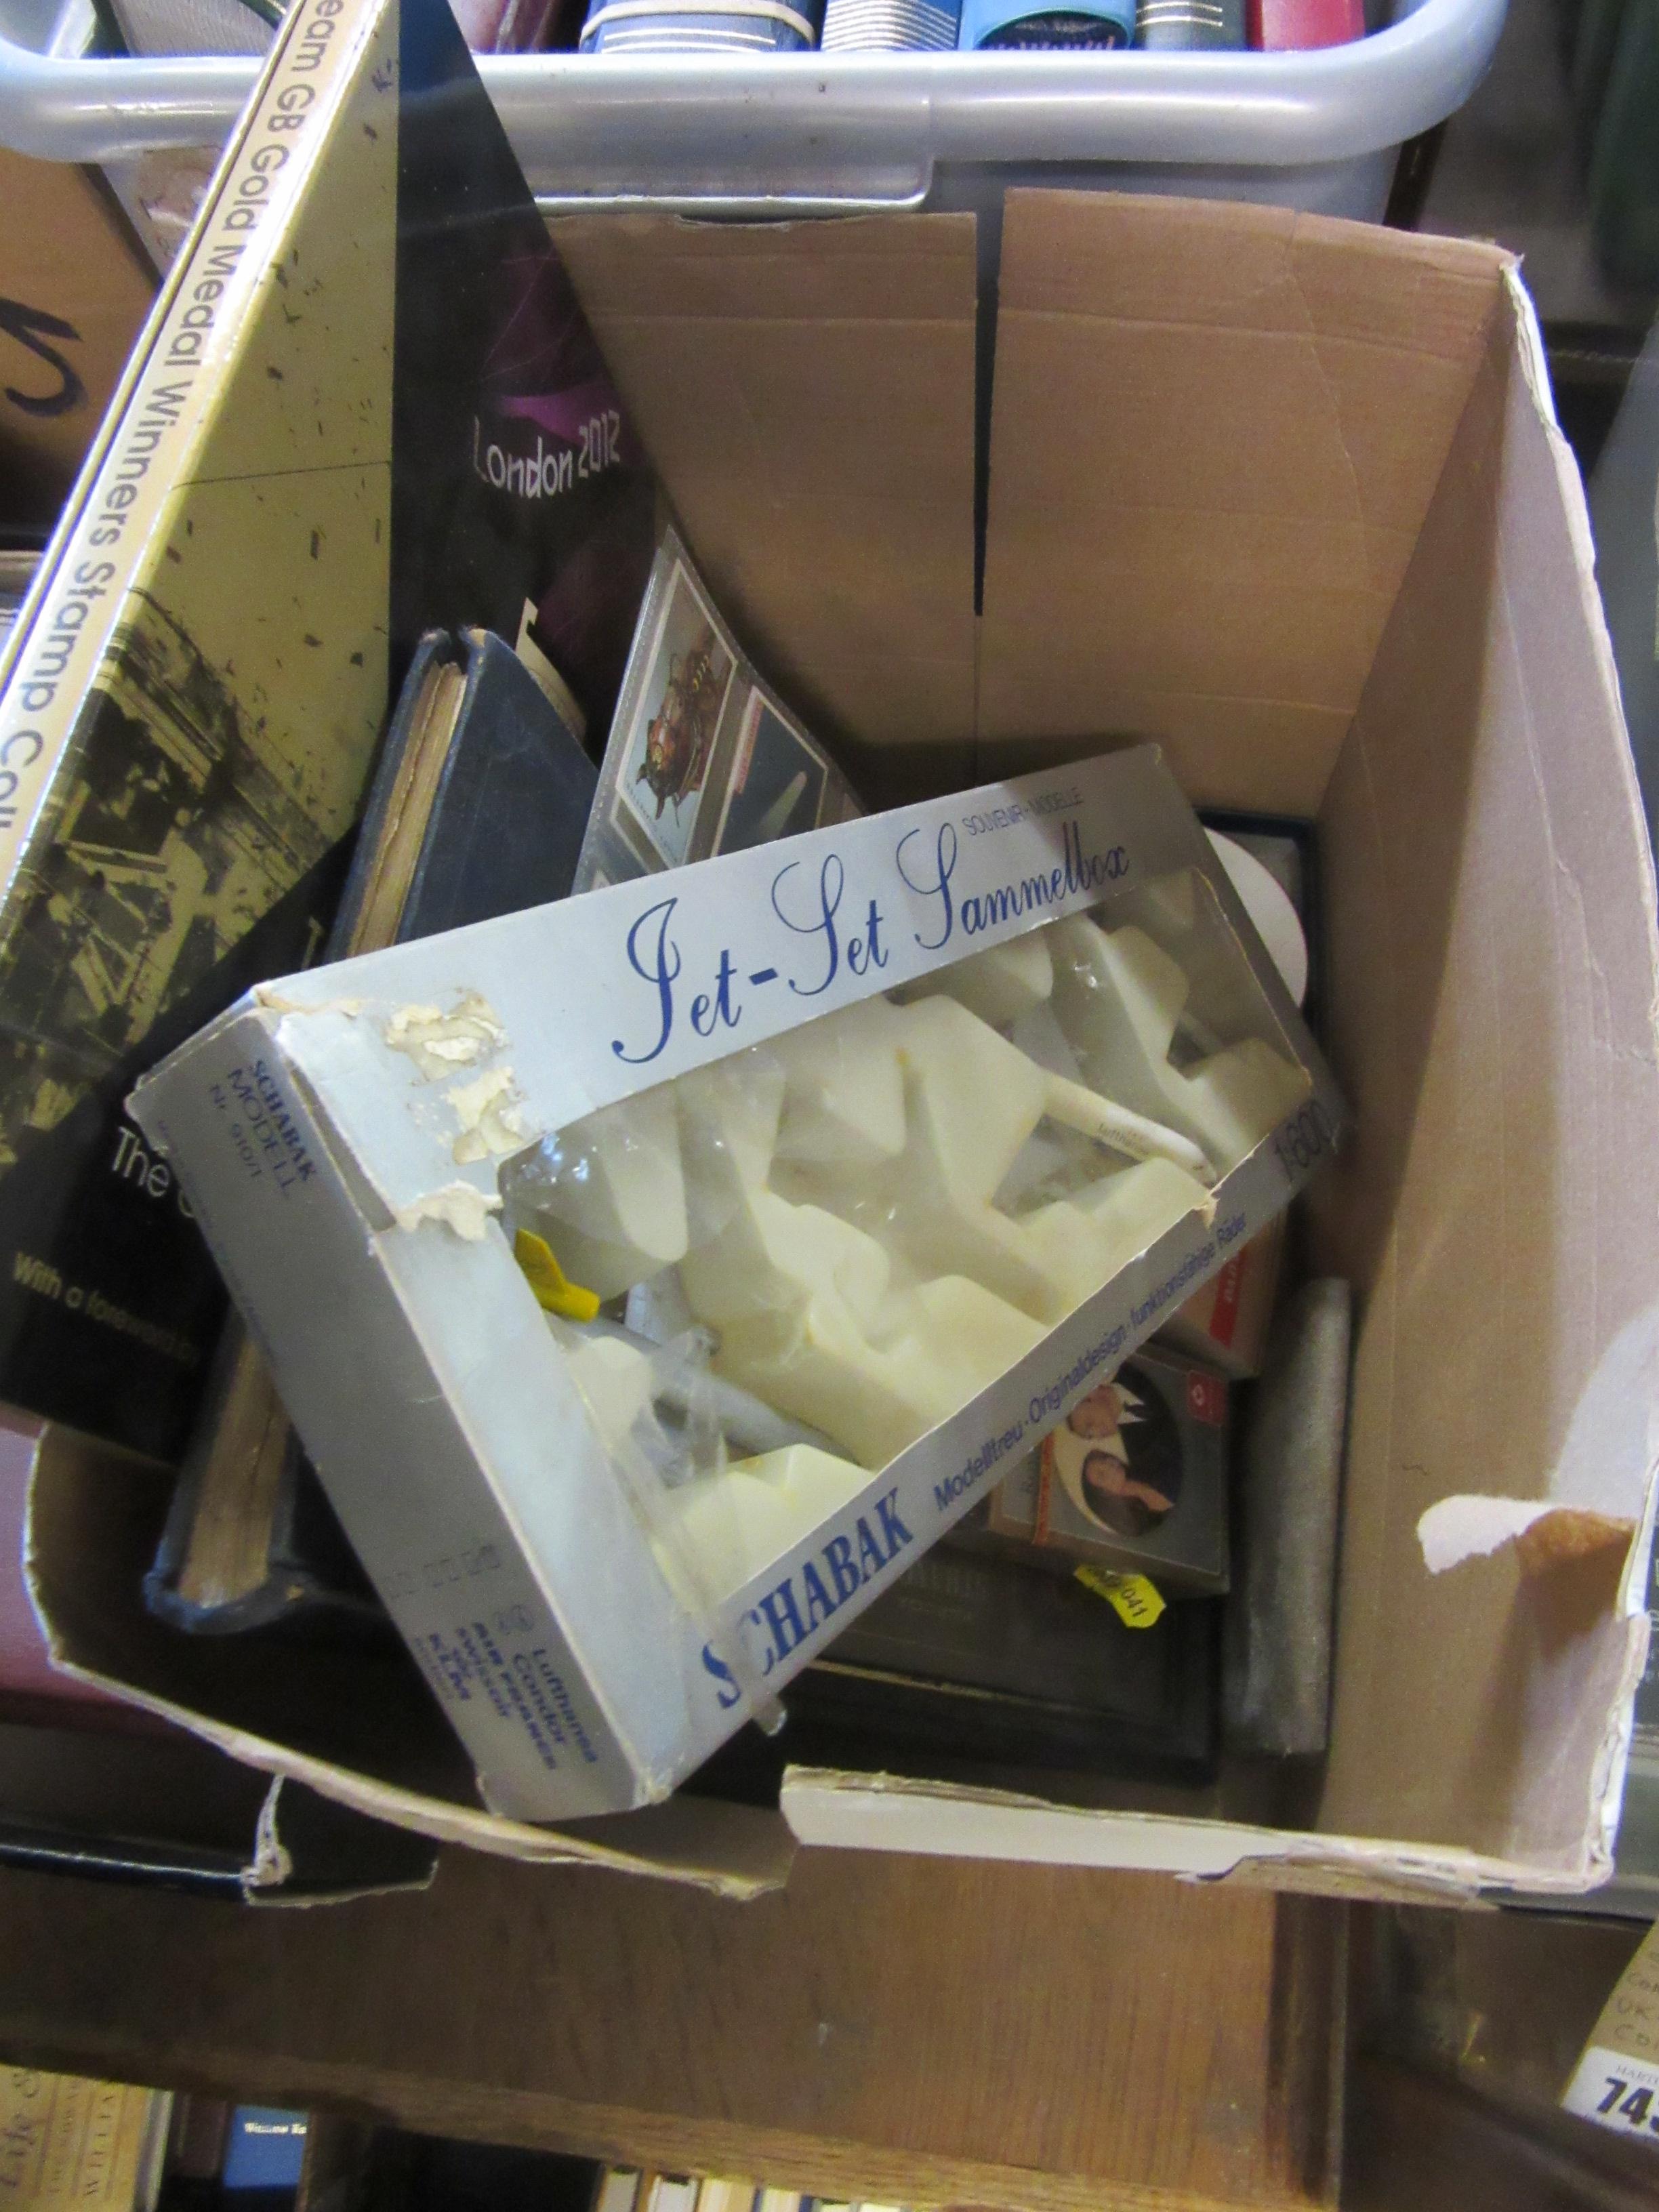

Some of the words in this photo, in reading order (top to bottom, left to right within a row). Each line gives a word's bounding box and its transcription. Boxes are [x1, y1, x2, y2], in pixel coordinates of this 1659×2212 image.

[268, 84, 316, 132] GB
[224, 145, 290, 230] Gold
[163, 244, 248, 367] Medal
[89, 379, 194, 547] Winners
[474, 415, 573, 499] London
[578, 409, 620, 478] 2012
[21, 561, 117, 712] Stamp
[611, 853, 889, 1064] Jet-Set
[895, 821, 1130, 949] Sammelbox
[112, 1126, 169, 1197] The
[228, 1068, 296, 1197] MODELL
[251, 1059, 317, 1182] SCHABAK
[702, 1486, 914, 1711] SCHABAK
[1029, 1326, 1128, 1424] Originaldesign
[1595, 2076, 1659, 2132] 74
